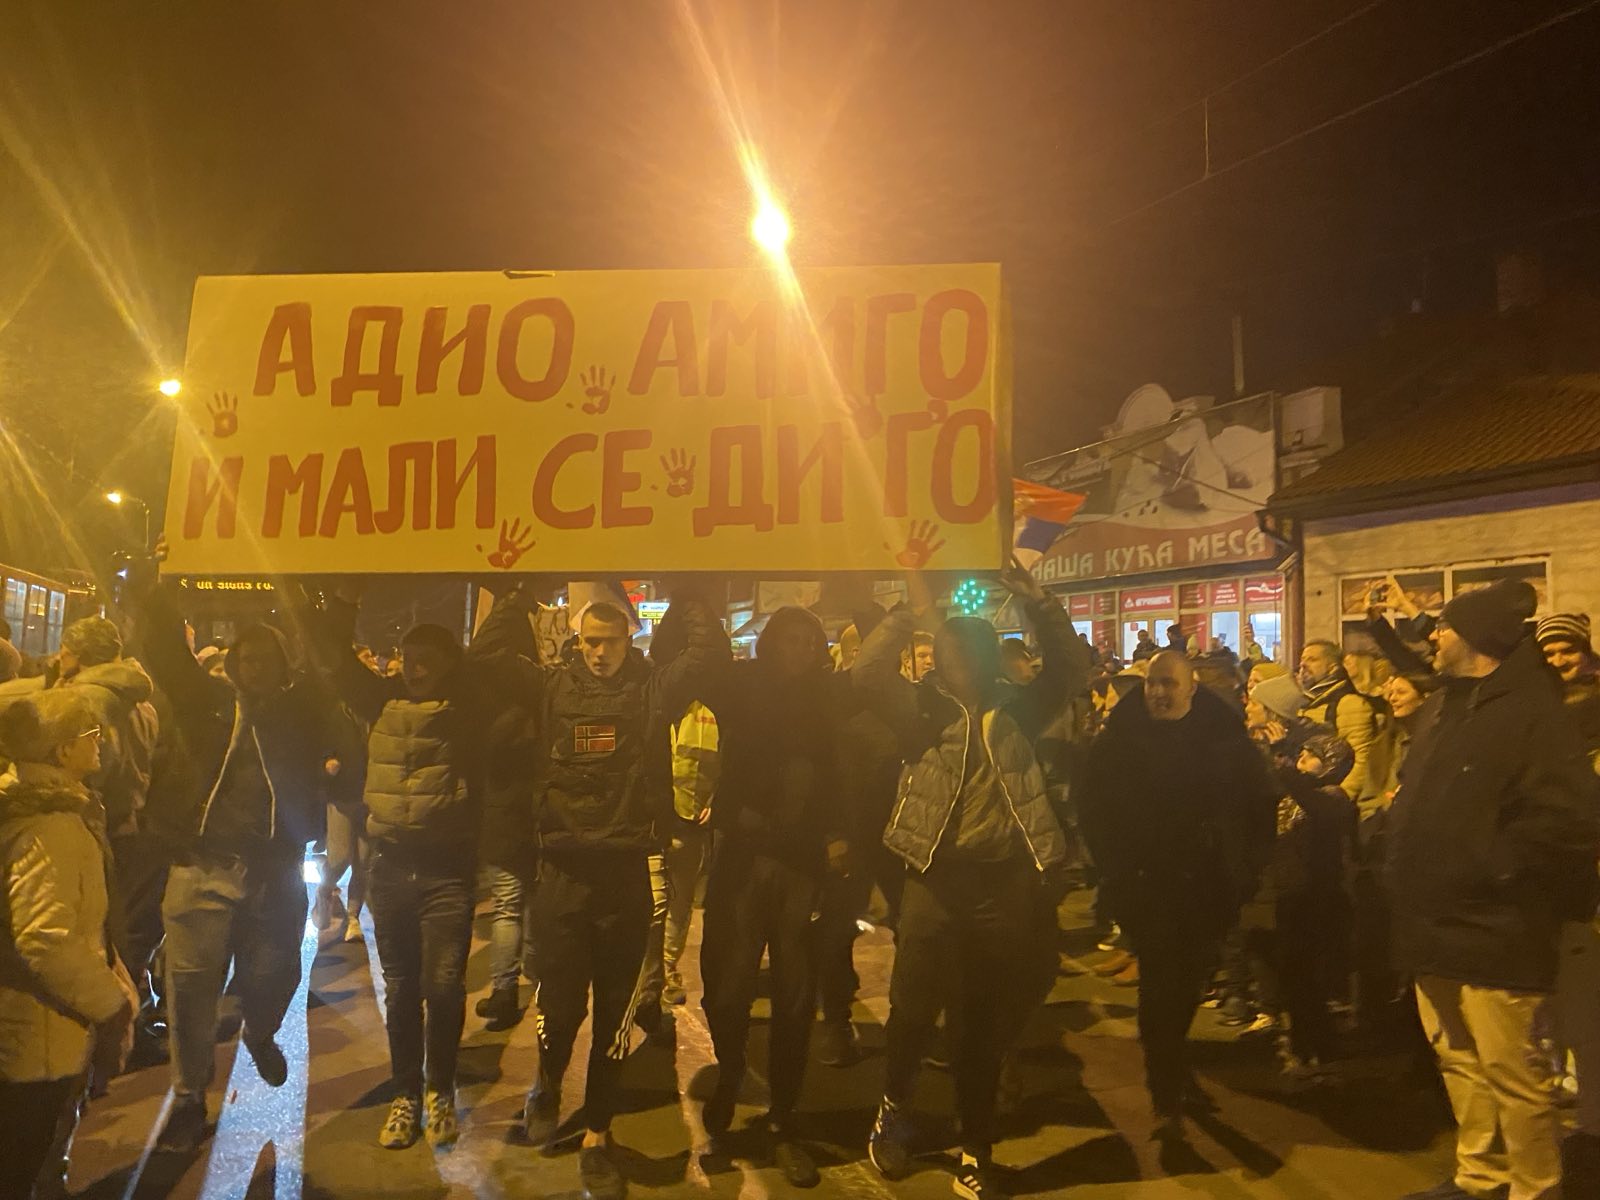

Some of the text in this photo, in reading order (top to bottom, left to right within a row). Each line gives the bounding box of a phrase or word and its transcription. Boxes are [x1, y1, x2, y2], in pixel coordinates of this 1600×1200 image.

[253, 289, 989, 407] АДИО АМИГО
[183, 455, 244, 540] И
[261, 434, 497, 538] МАЛИ
[532, 429, 654, 530] СЕ
[1105, 540, 1174, 572] КУЋА
[1188, 526, 1267, 562] МЕСА
